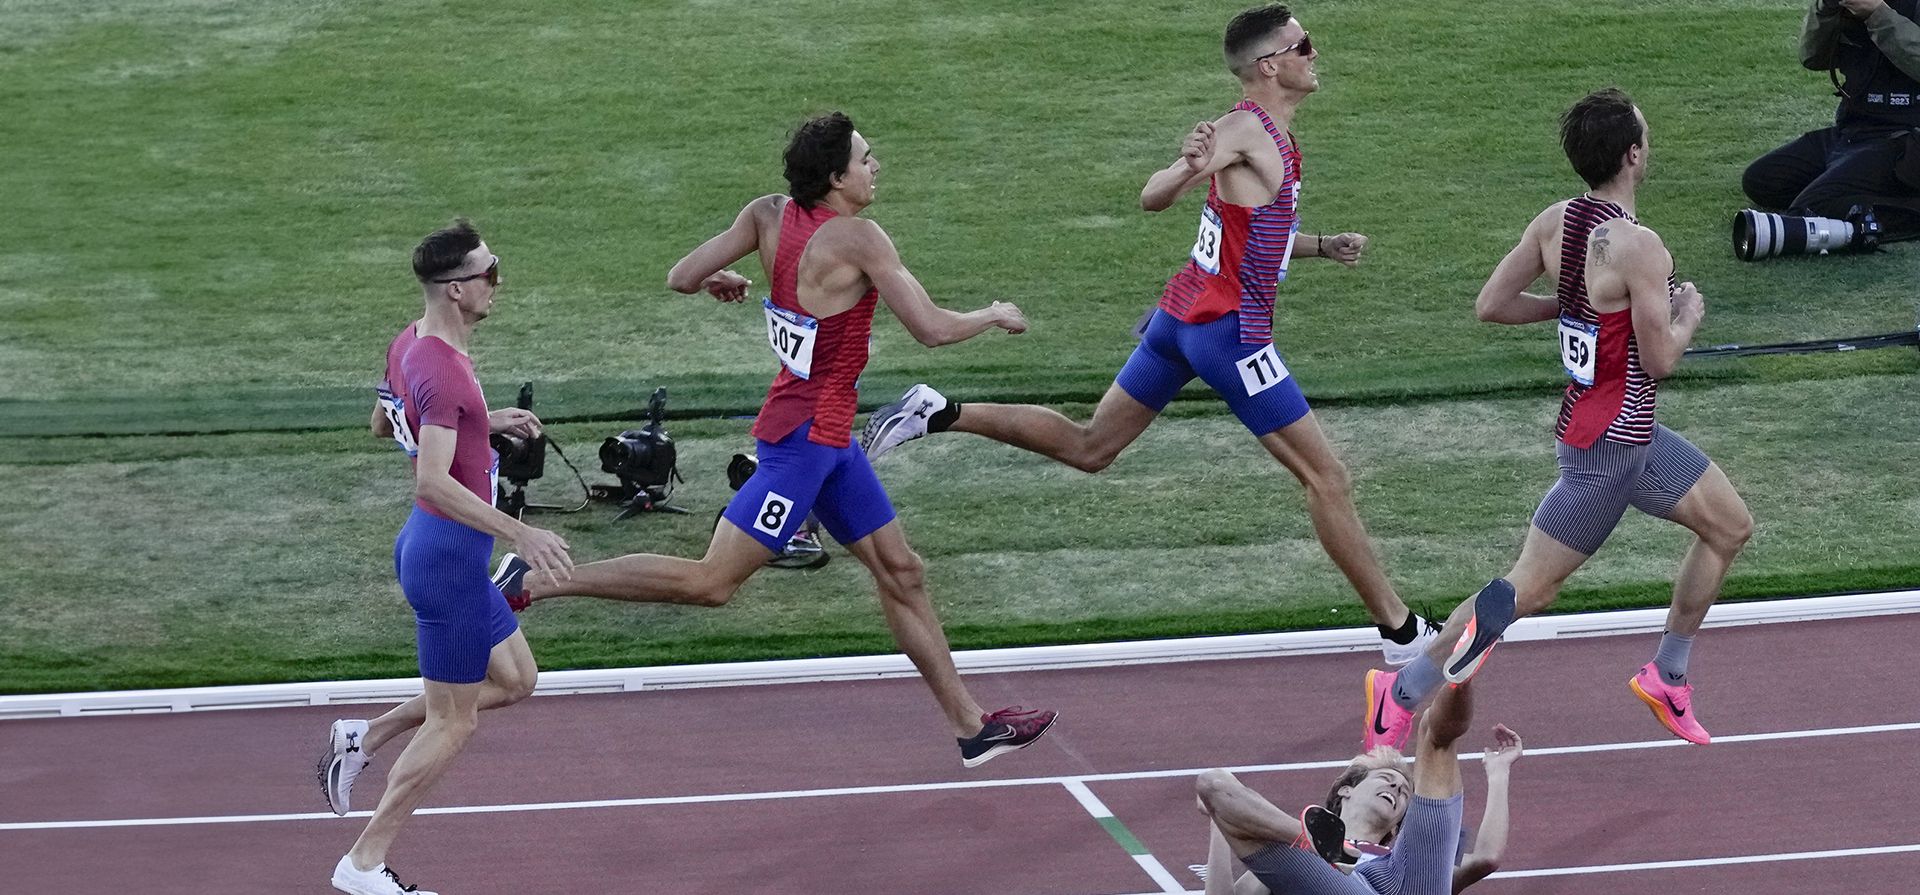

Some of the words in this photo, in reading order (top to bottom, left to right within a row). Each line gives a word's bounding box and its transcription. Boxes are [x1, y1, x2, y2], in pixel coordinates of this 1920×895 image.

[1199, 226, 1216, 259] 63
[771, 317, 805, 361] 507
[1560, 331, 1589, 369] 159
[1246, 351, 1279, 386] 11
[761, 500, 786, 530] 8
